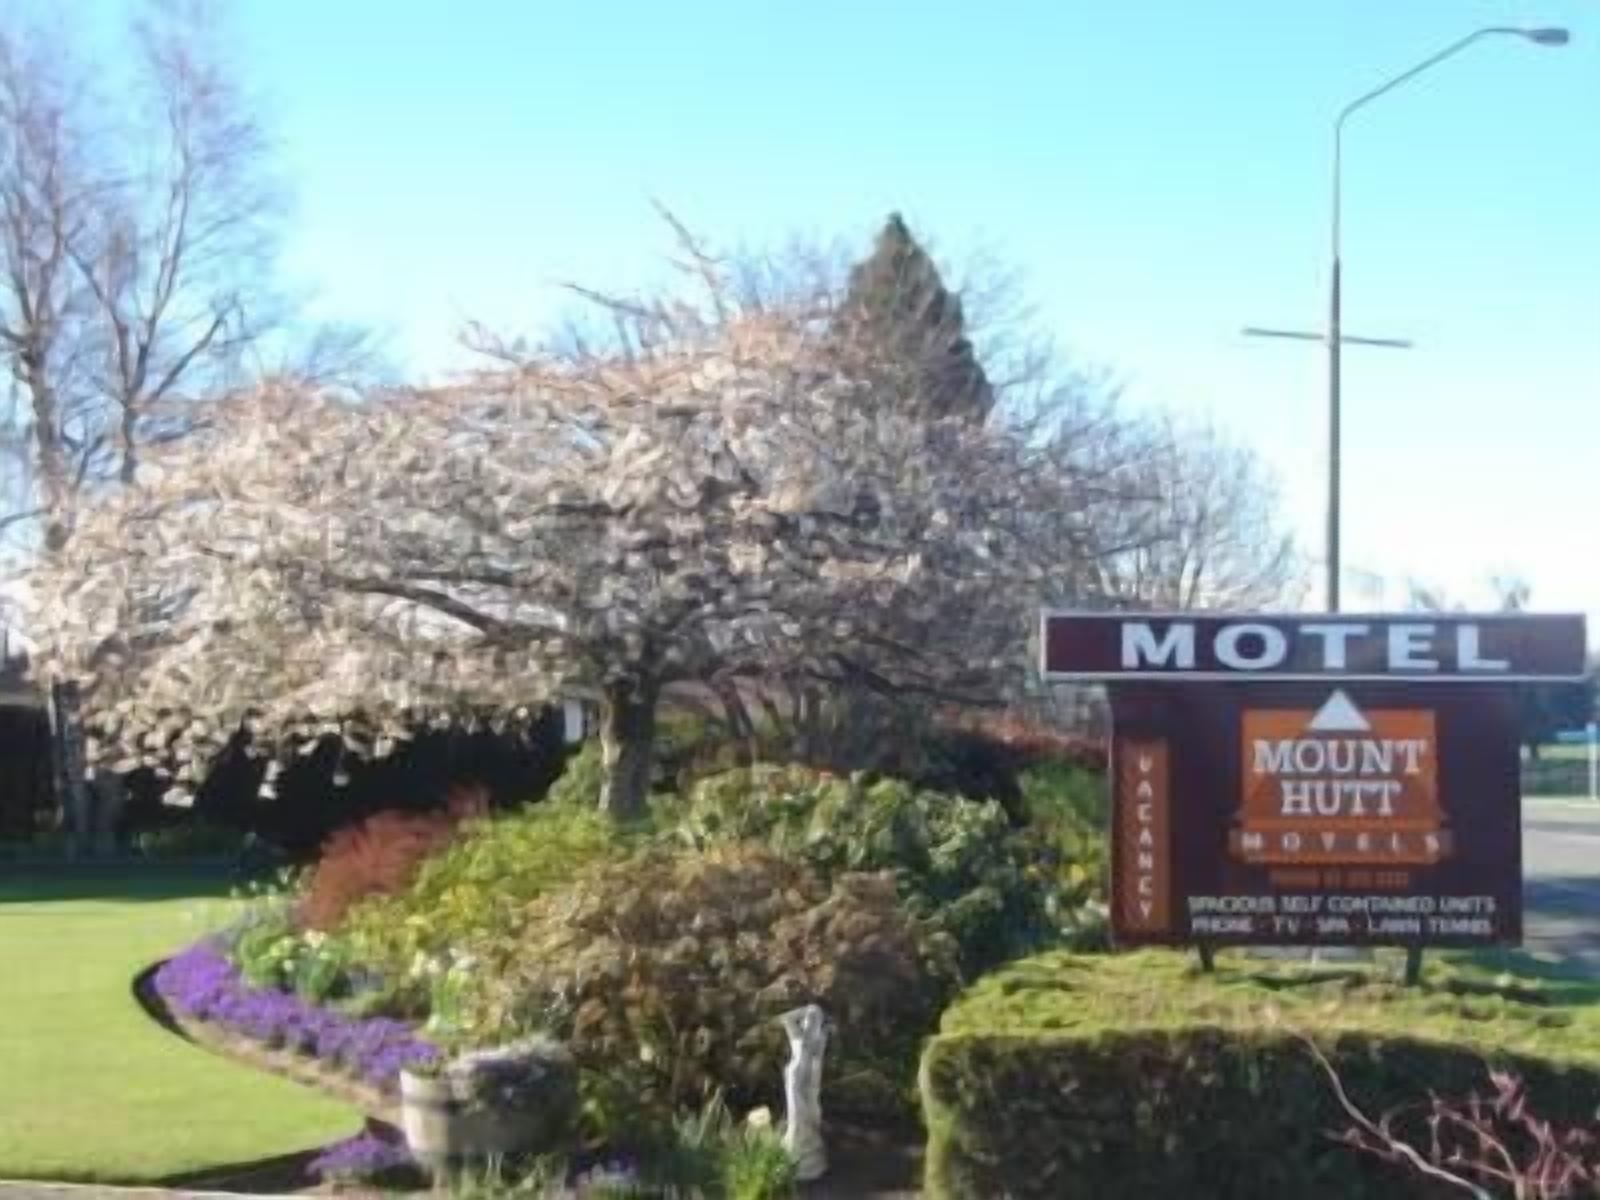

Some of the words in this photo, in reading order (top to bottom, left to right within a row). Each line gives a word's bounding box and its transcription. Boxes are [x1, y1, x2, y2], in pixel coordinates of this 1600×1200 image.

[1121, 622, 1510, 670] MOTEL
[1252, 739, 1427, 774] MOUNT
[1280, 779, 1402, 816] HUTT
[1136, 754, 1154, 918] VACANCY
[1274, 915, 1300, 934] TV
